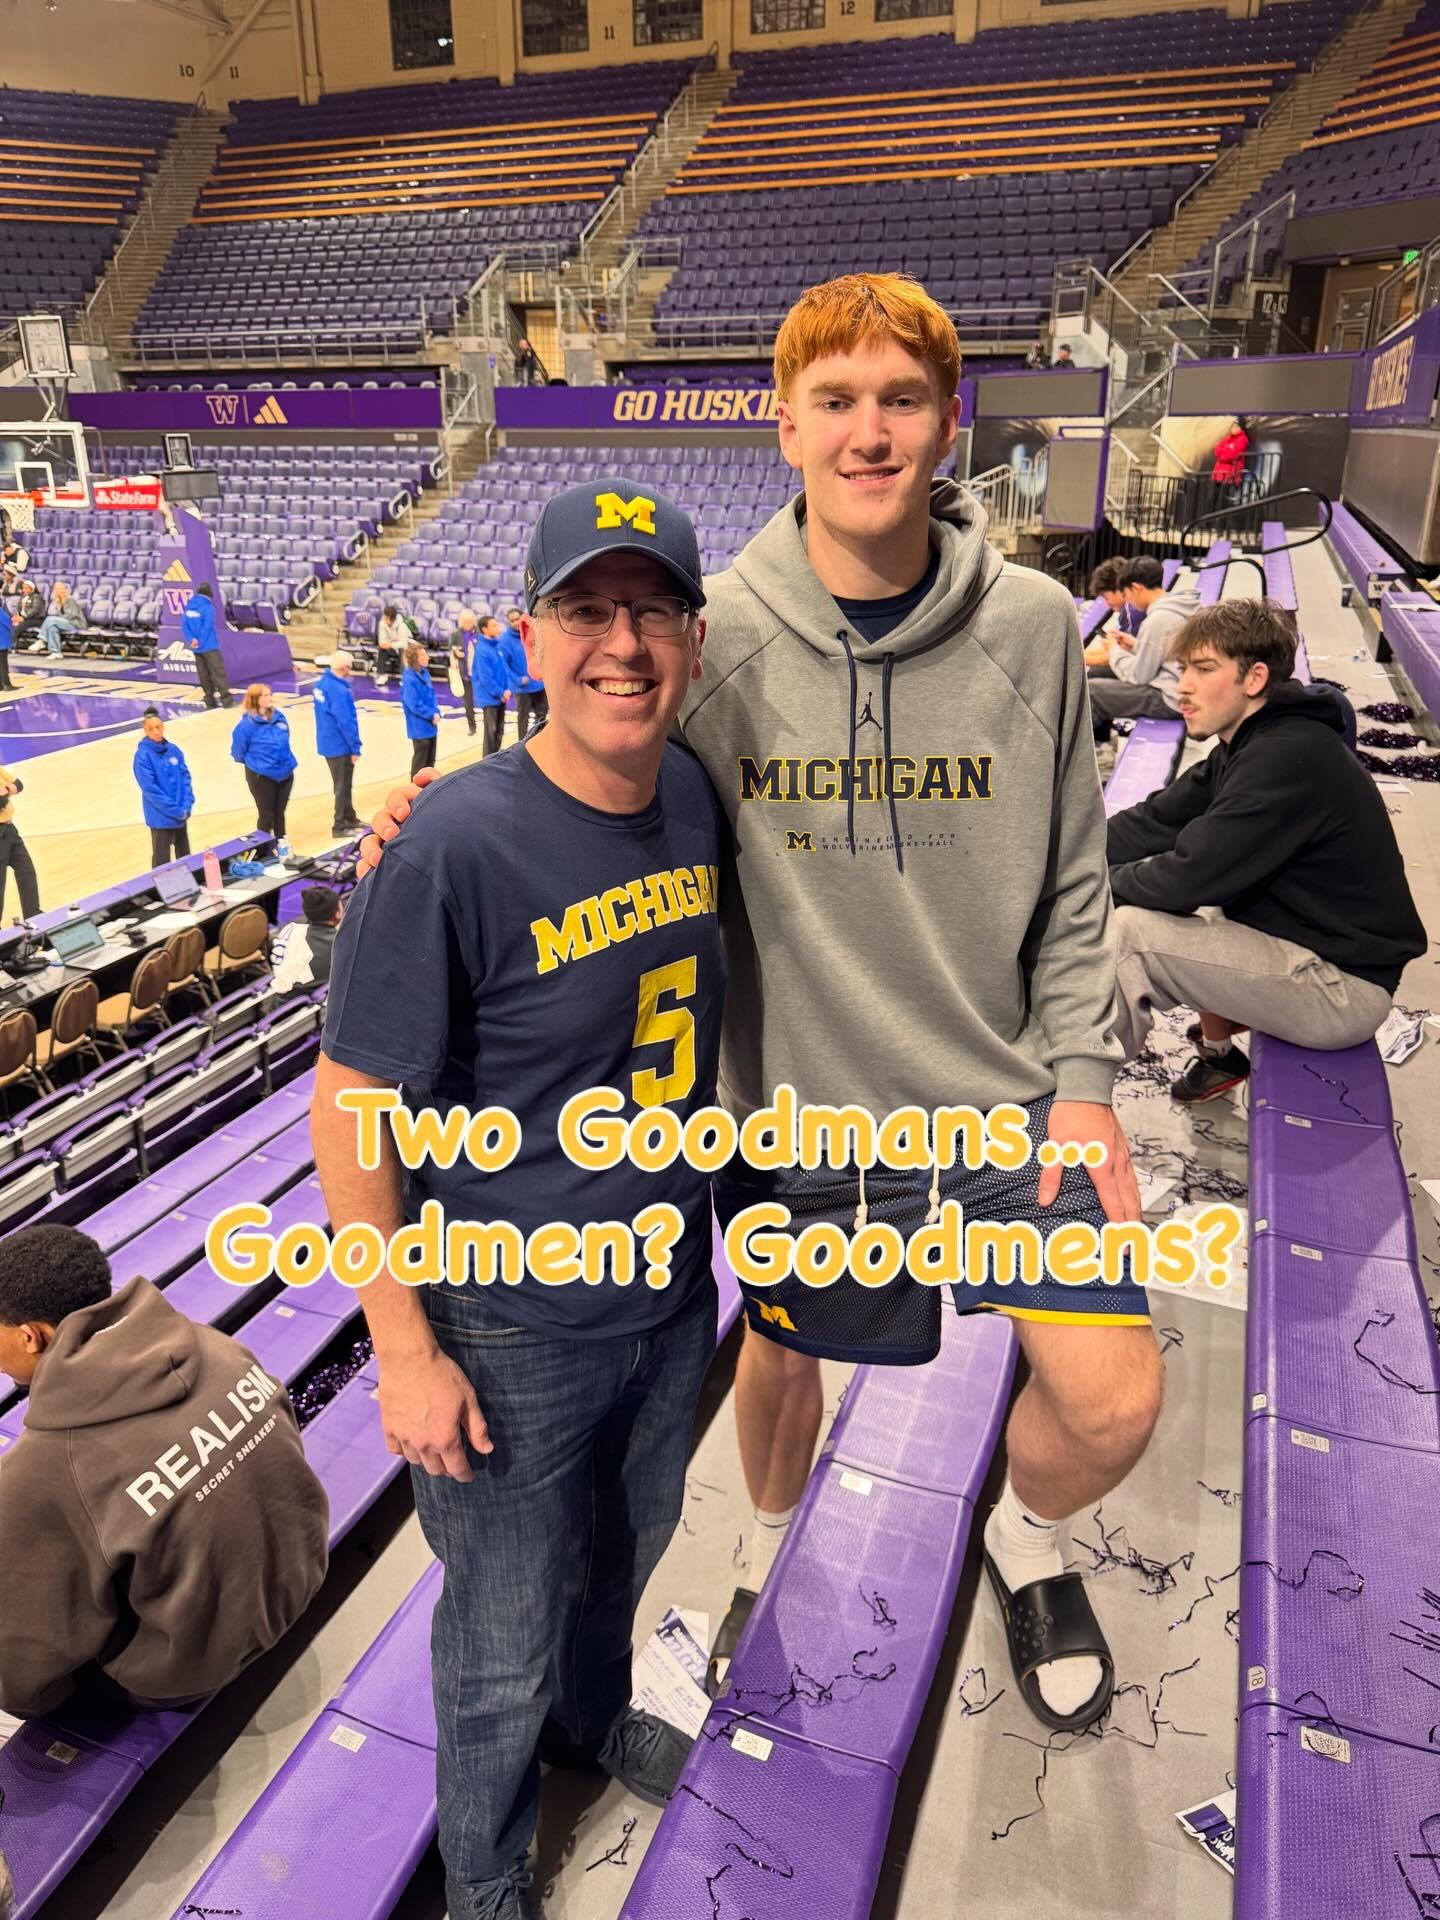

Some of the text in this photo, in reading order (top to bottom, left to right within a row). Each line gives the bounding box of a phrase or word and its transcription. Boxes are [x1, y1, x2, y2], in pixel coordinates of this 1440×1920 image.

[840, 2, 855, 17] 12
[604, 26, 615, 40] 11
[179, 64, 195, 78] 10
[205, 395, 239, 424] W
[612, 390, 658, 421] GO
[595, 492, 656, 536] M
[738, 755, 993, 803] MICHIGAN
[785, 829, 814, 851] M
[631, 954, 697, 1110] 5
[125, 1364, 278, 1518] REALISM
[195, 1459, 235, 1502] SECRET
[1250, 1669, 1263, 1686] 18
